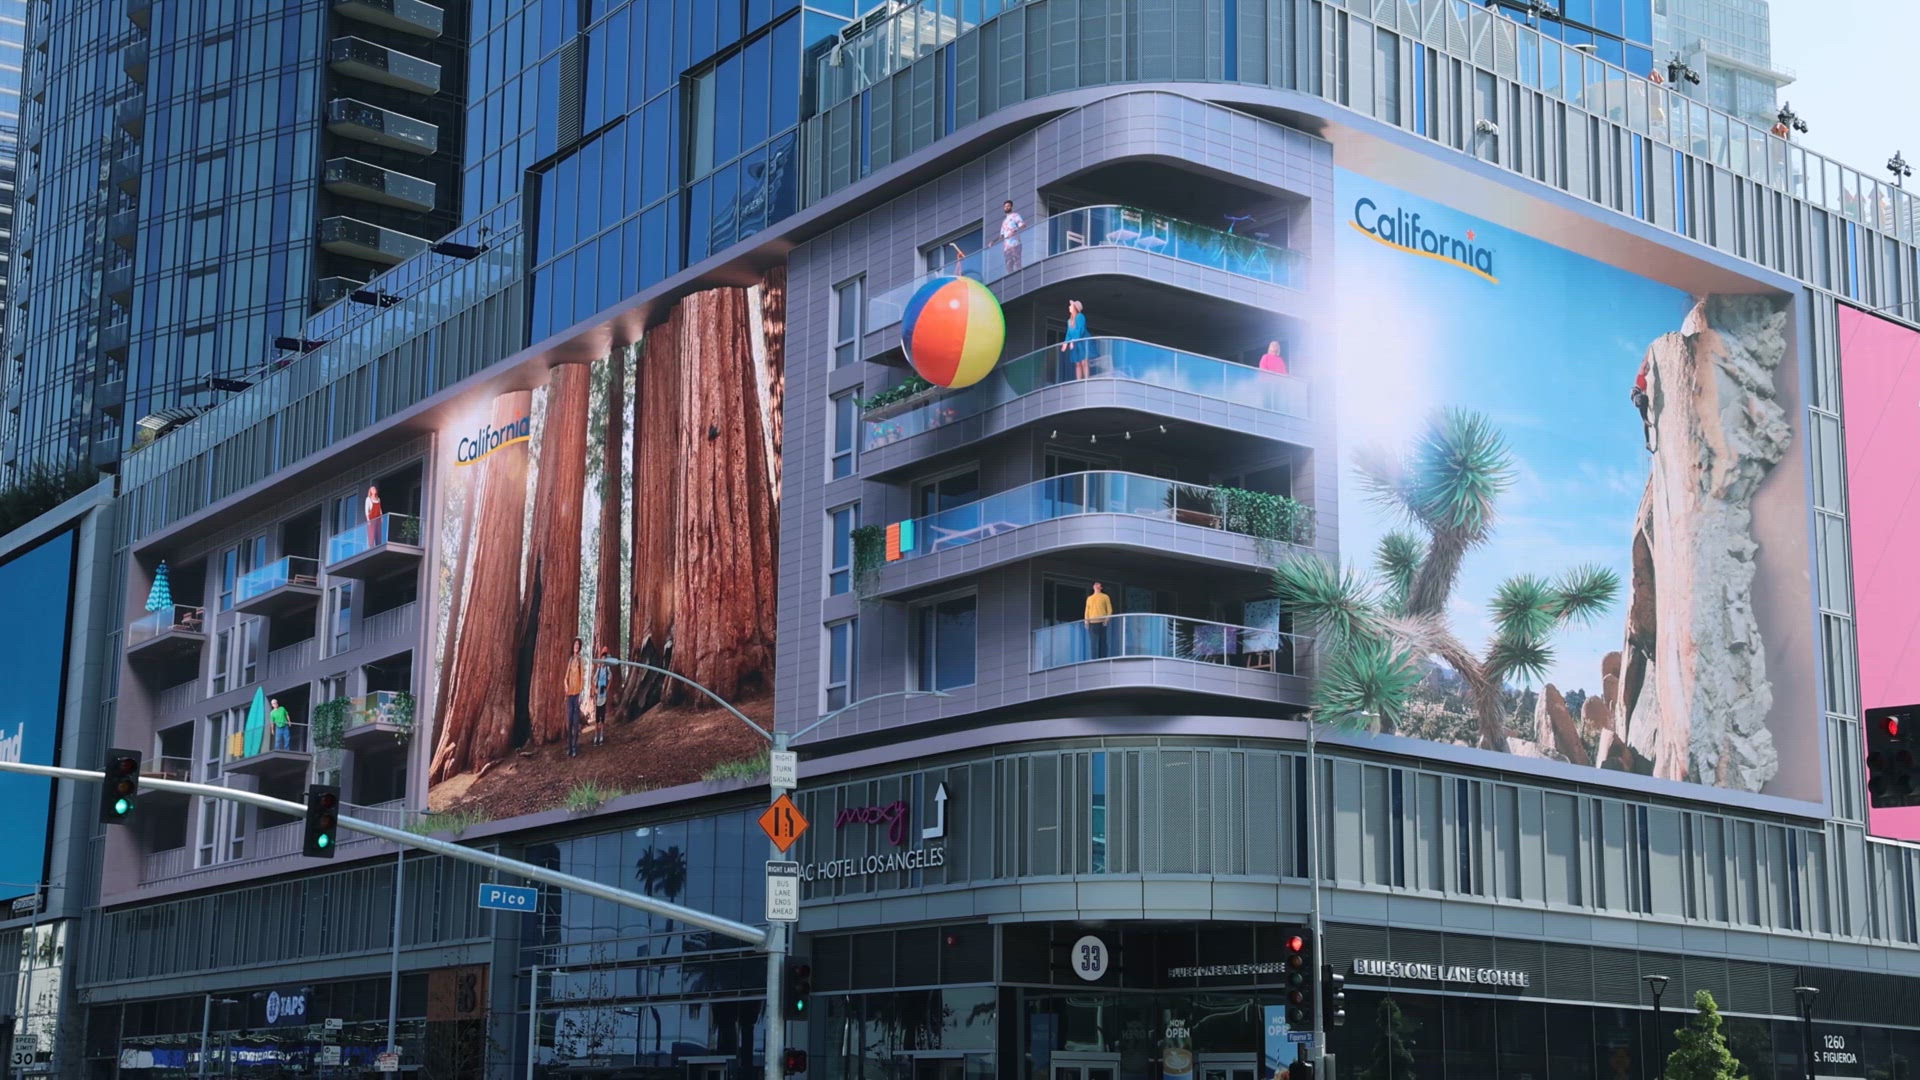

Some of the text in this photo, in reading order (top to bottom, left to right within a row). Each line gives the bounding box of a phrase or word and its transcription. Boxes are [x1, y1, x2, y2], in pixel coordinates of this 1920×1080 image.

[1354, 196, 1493, 276] California
[457, 411, 530, 463] California
[774, 754, 793, 762] RIGHT
[775, 765, 792, 773] TURN
[772, 776, 795, 784] SIGNAL
[768, 865, 797, 874] RIGHT LANE
[799, 864, 815, 882] AC
[817, 858, 857, 880] HOTEL
[776, 880, 790, 888] BUS
[490, 890, 525, 905] Pico
[774, 889, 791, 897] LANE
[774, 898, 792, 906] ENDS
[771, 907, 794, 915] AHEAD
[1080, 944, 1101, 972] 33
[1354, 958, 1530, 987] BLUESTONE LANE COFFEE
[1169, 1019, 1186, 1028] NOW
[1165, 1028, 1191, 1039] OPEN
[1268, 1025, 1287, 1036] OPE
[1823, 1034, 1845, 1049] 1260
[13, 1052, 33, 1065] 30
[1814, 1051, 1857, 1064] S. FIGUEROA
